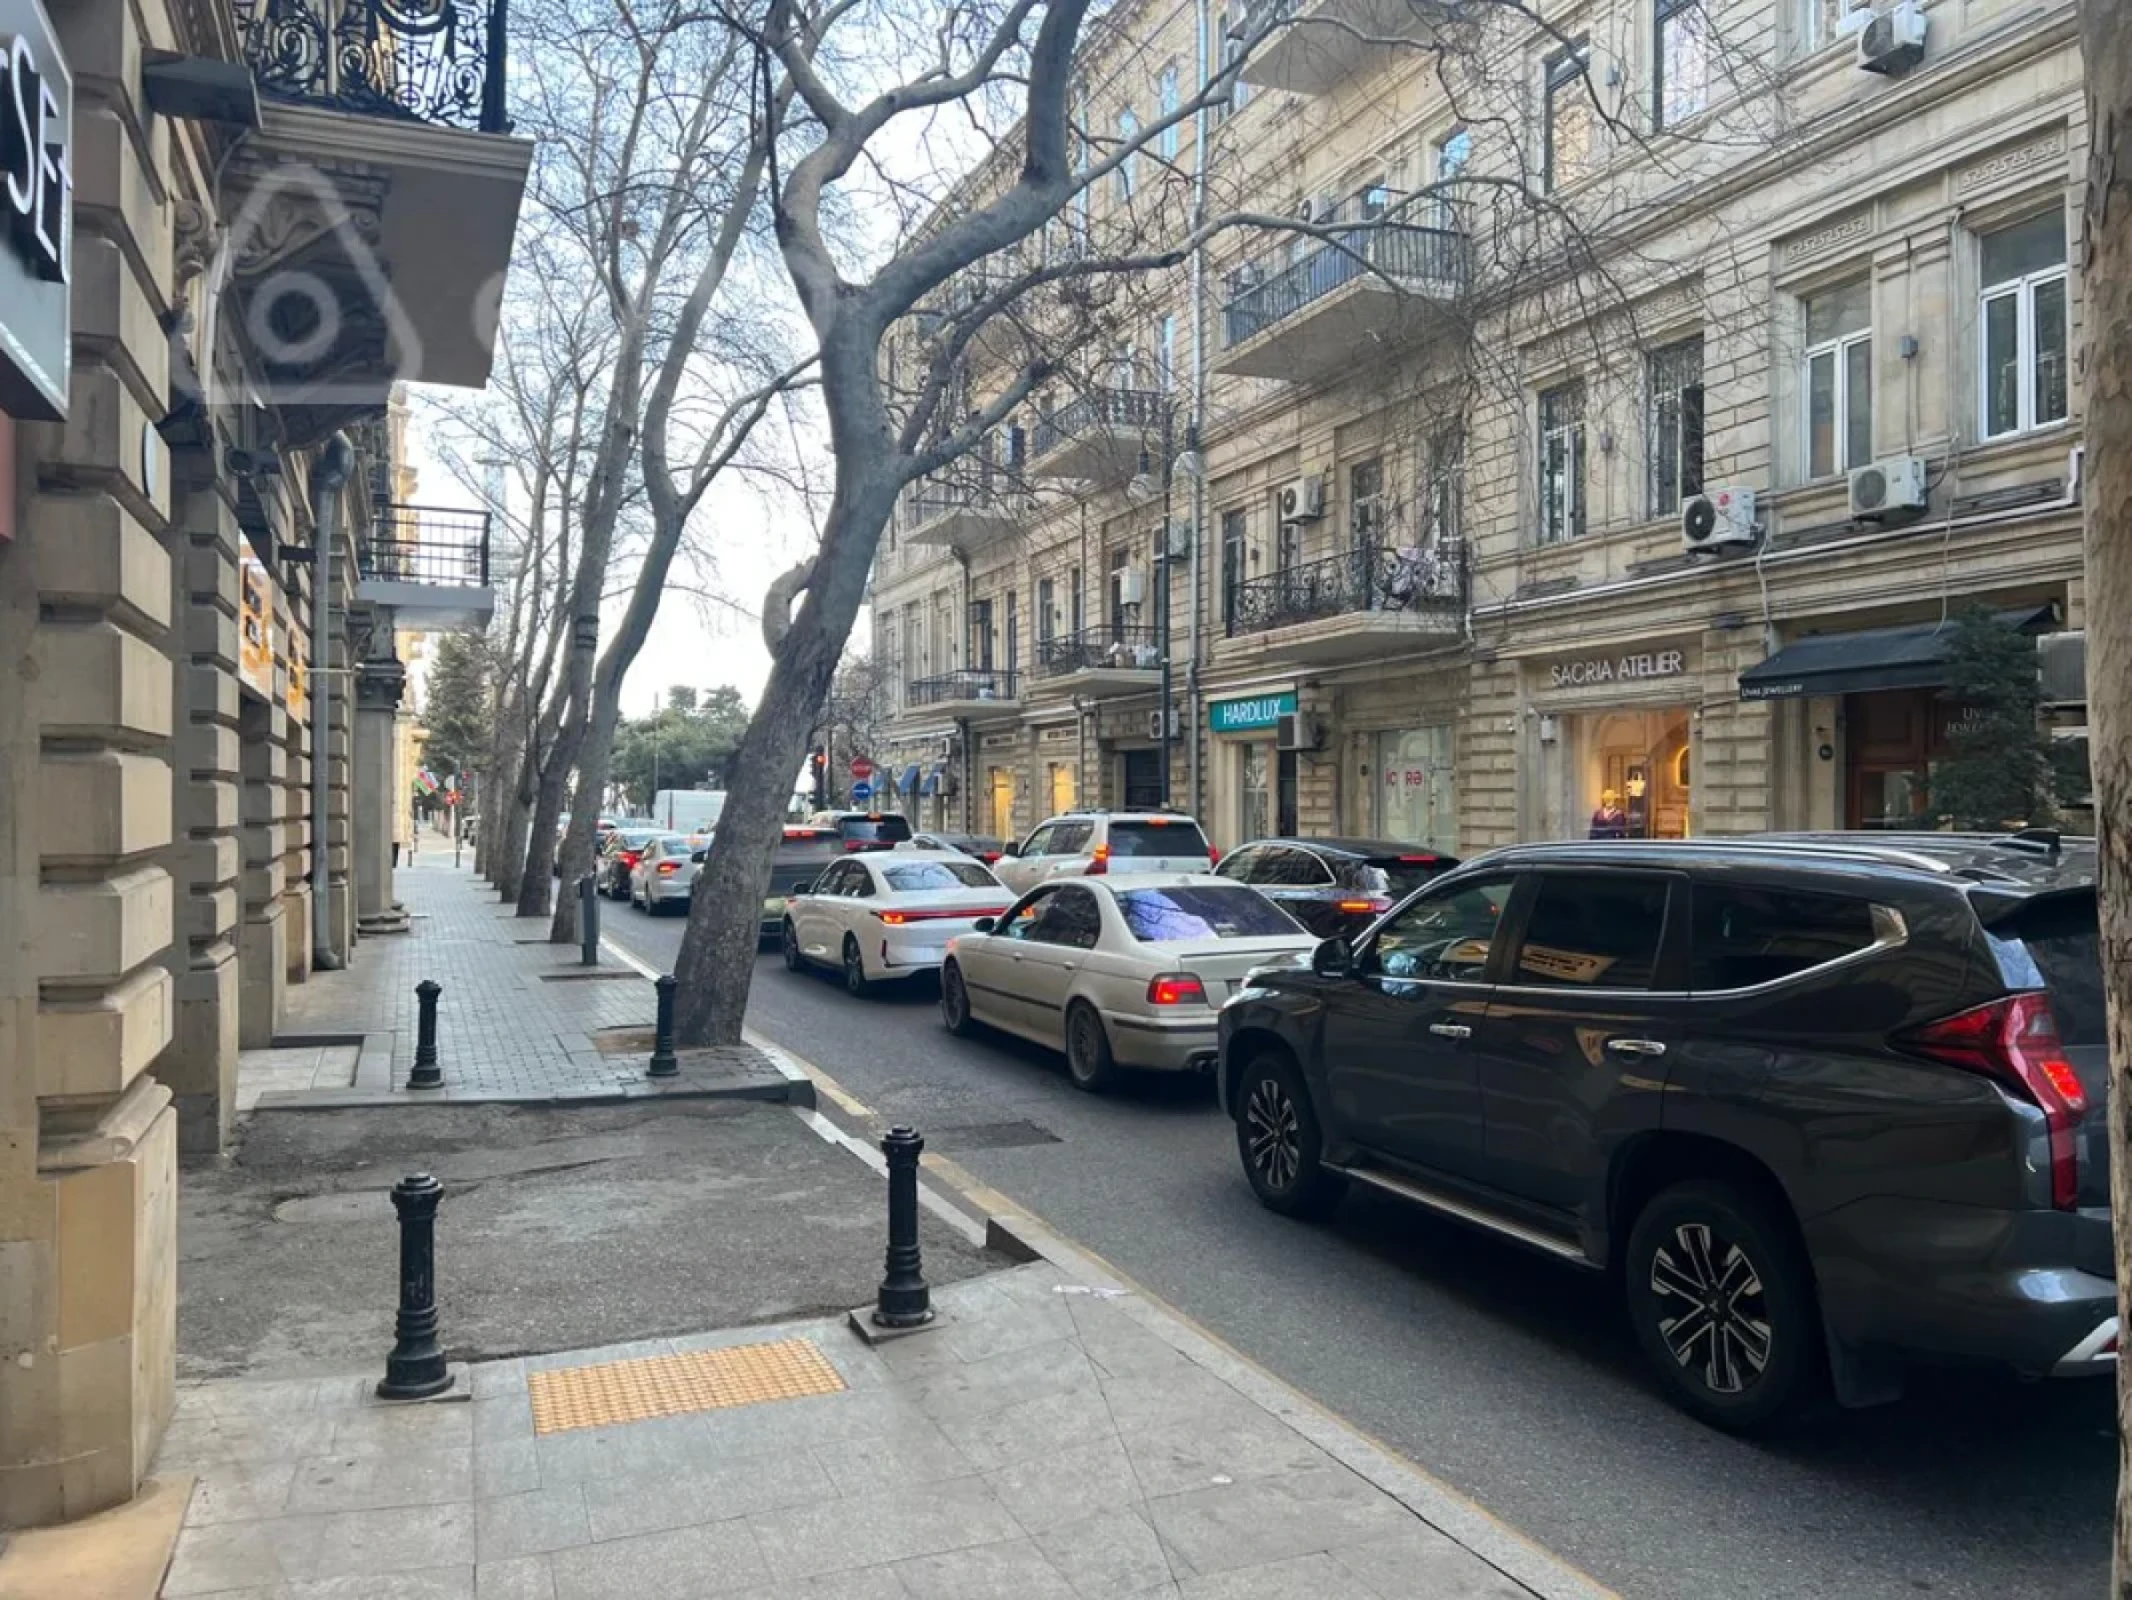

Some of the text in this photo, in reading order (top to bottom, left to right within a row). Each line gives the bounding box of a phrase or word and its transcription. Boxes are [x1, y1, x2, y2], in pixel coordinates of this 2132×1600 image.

[1550, 650, 1682, 687] SACRIA ATELIER
[1223, 697, 1281, 724] HARDLUX
